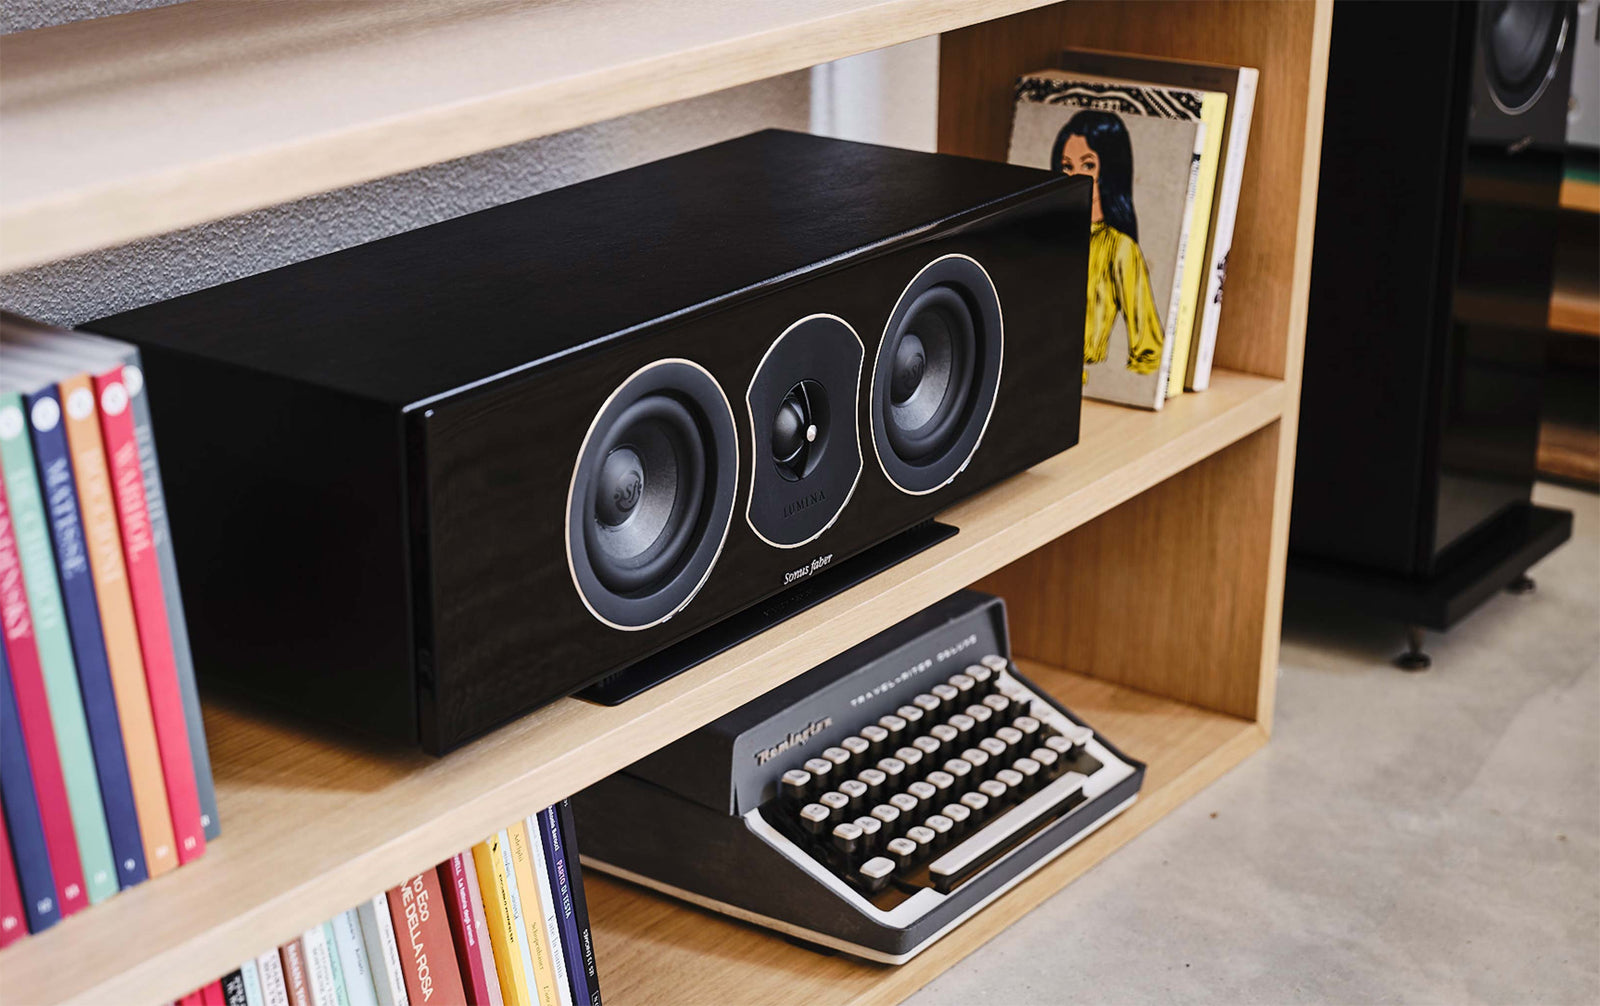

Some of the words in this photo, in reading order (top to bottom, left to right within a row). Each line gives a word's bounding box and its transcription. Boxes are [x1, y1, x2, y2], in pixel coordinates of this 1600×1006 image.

[46, 457, 87, 580] MATISSE
[115, 440, 152, 563] WARHOL
[783, 490, 826, 518] LUMINA
[784, 565, 810, 585] Sonus
[808, 553, 833, 576] faber
[936, 633, 978, 662] DELUXE
[754, 716, 833, 767] Remington
[556, 859, 566, 886] PARTO
[562, 894, 573, 920] TESTA
[405, 904, 424, 958] DELLA
[416, 953, 434, 1003] ROSA
